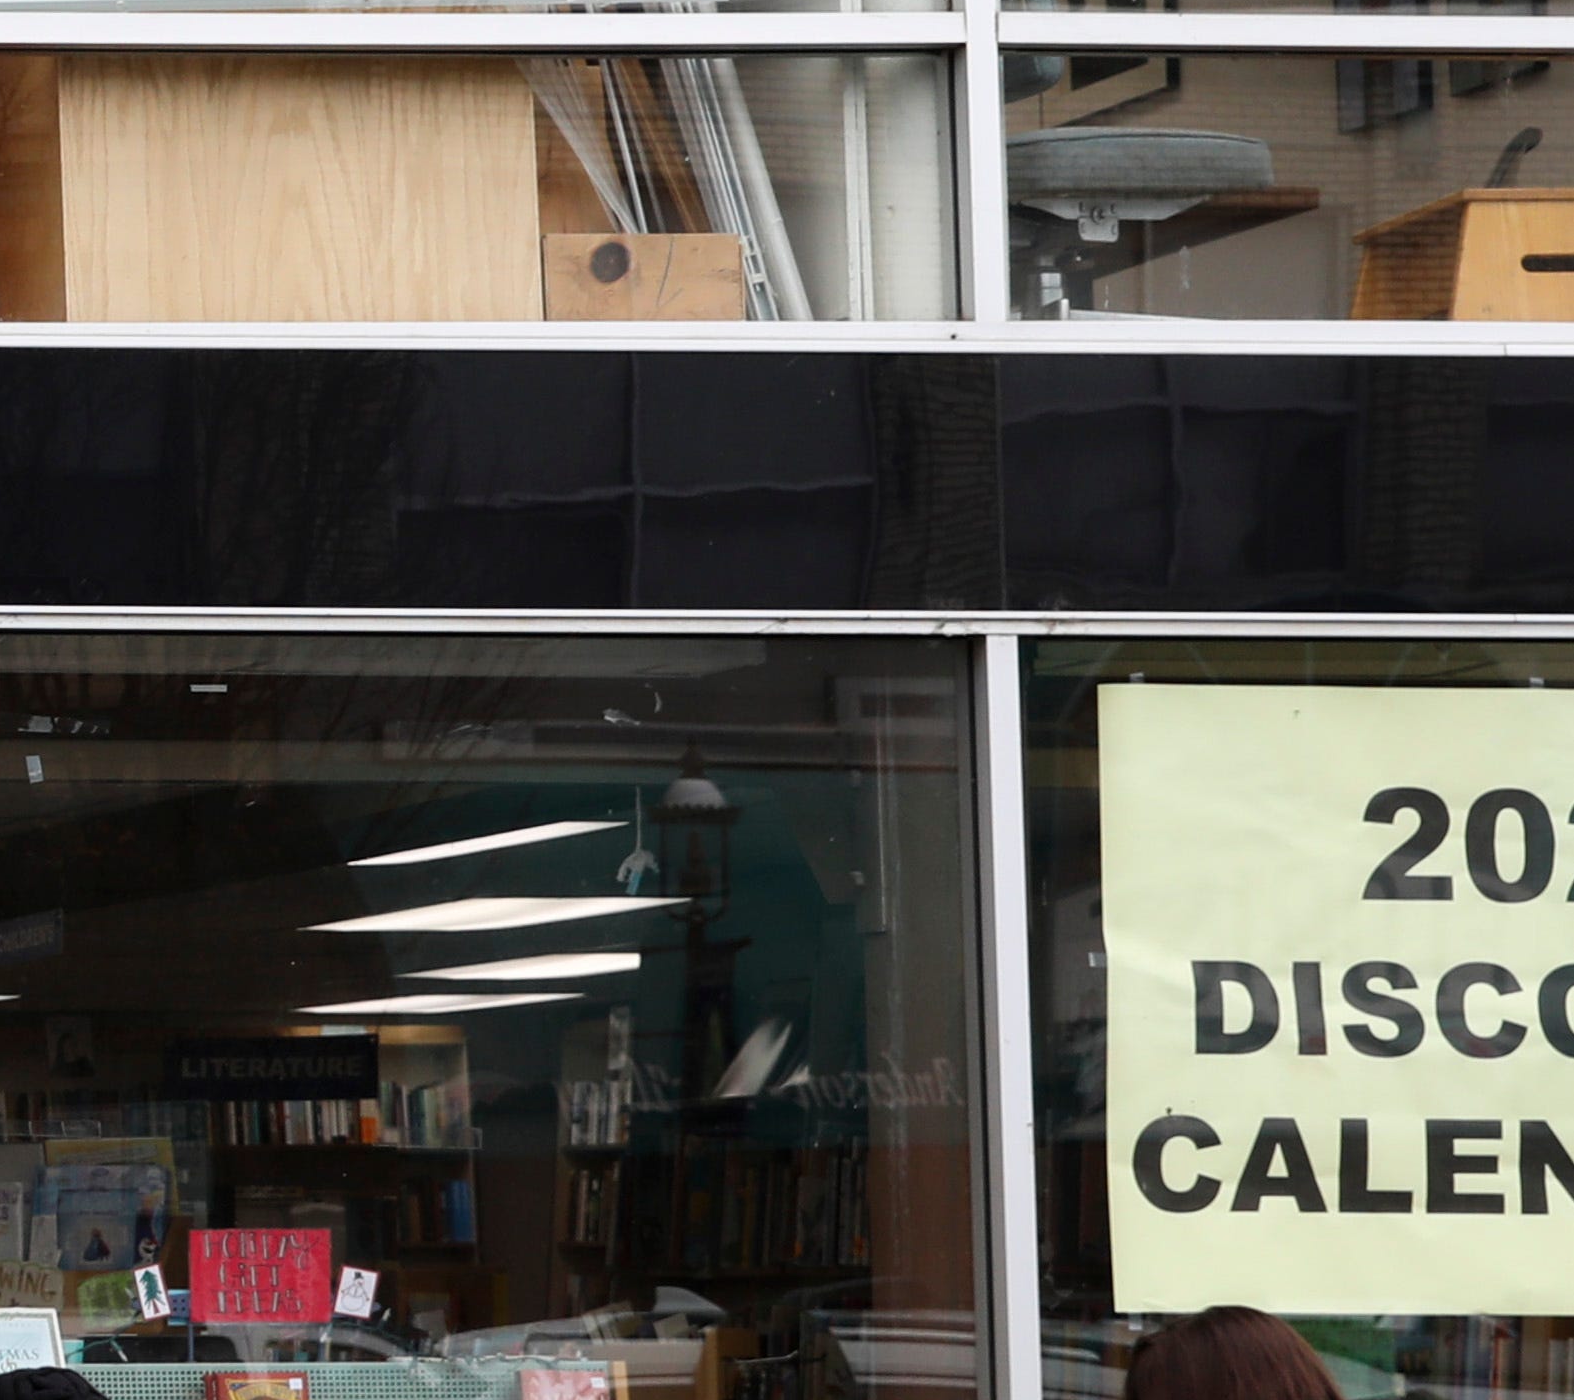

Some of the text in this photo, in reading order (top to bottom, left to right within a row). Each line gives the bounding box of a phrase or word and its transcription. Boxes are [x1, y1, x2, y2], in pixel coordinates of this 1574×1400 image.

[1361, 787, 1574, 903] 20
[180, 1055, 362, 1079] LITERATURE
[203, 1231, 320, 1271] HOLIDAY
[218, 1263, 282, 1288] GIFT
[207, 1289, 304, 1314] IDEAS
